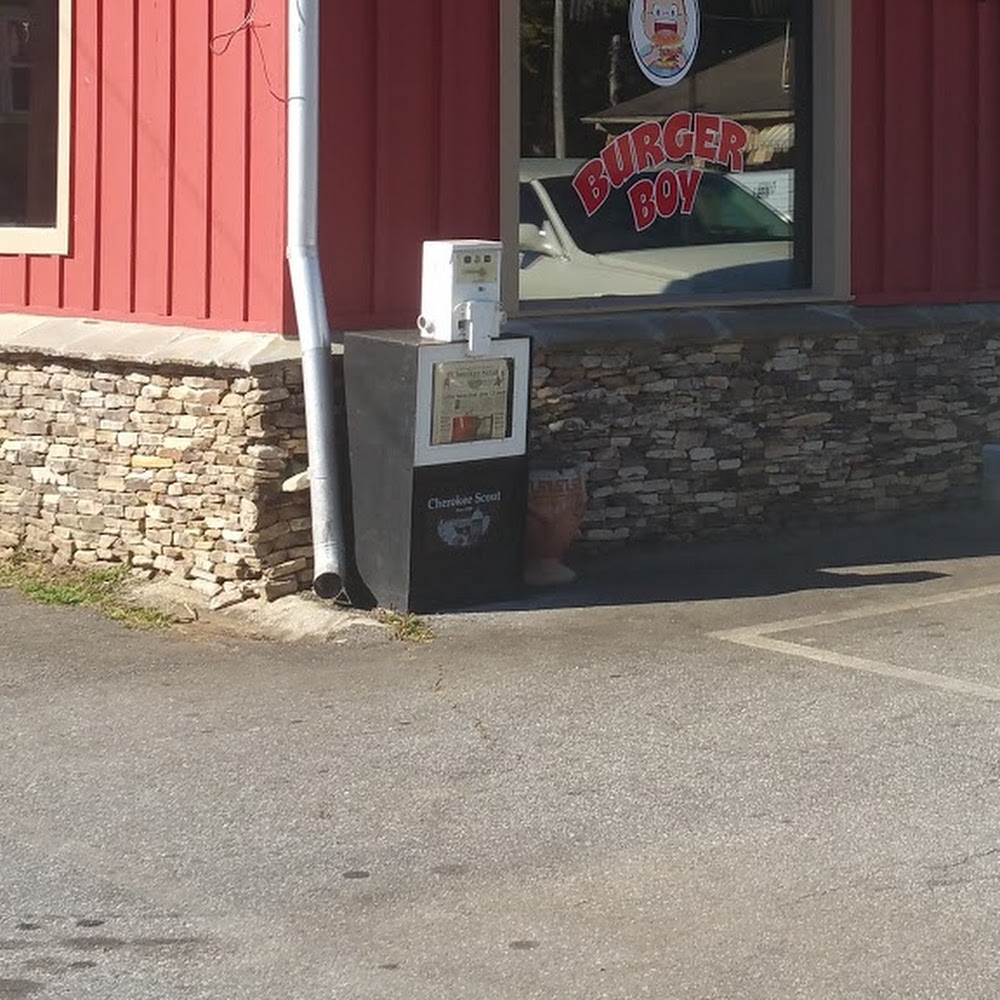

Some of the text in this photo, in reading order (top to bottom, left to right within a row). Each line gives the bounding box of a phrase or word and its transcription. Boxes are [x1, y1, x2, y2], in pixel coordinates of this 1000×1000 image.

[572, 111, 748, 217] BURGER
[627, 169, 702, 232] BOY
[428, 495, 473, 509] Cherokee
[475, 491, 501, 504] Scout
